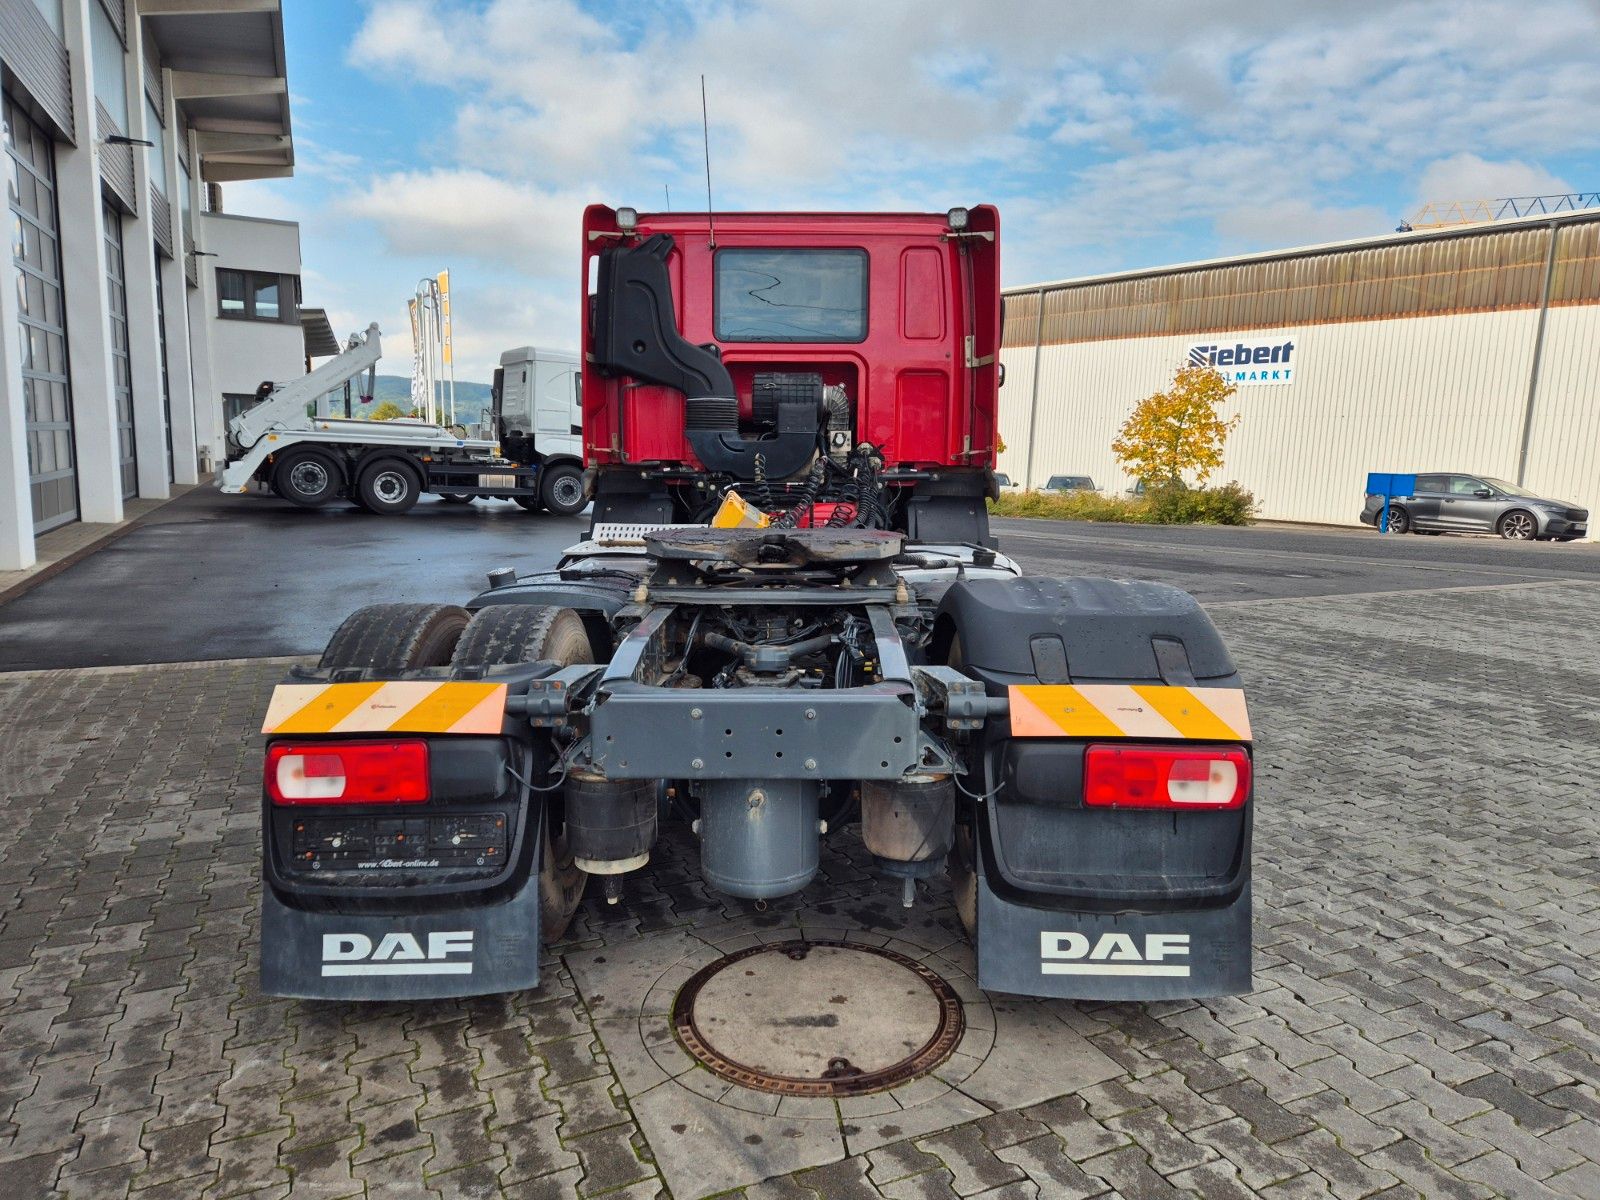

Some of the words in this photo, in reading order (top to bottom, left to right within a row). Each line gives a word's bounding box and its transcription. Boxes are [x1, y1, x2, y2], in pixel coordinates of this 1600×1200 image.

[1189, 341, 1294, 367] Siebert
[1222, 370, 1292, 382] LMARKT
[322, 931, 474, 961] DAF
[1040, 931, 1190, 961] DAF
